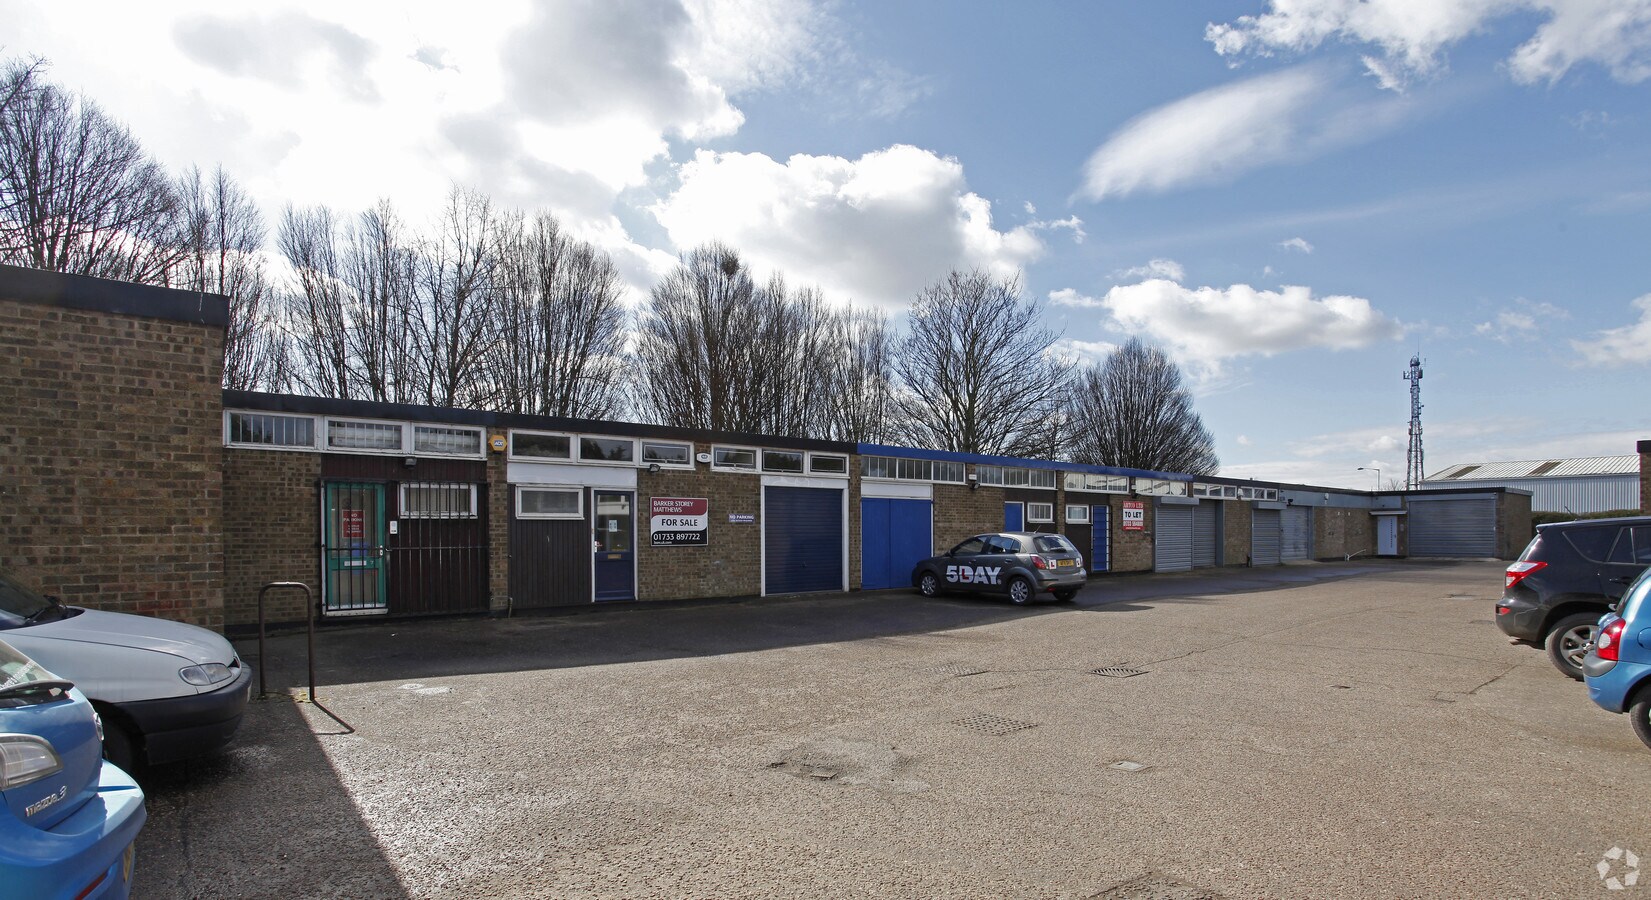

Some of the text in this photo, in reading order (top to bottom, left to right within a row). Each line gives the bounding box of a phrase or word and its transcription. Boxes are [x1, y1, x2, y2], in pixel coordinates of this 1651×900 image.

[661, 518, 698, 527] FOR SALE
[653, 533, 675, 541] 01733
